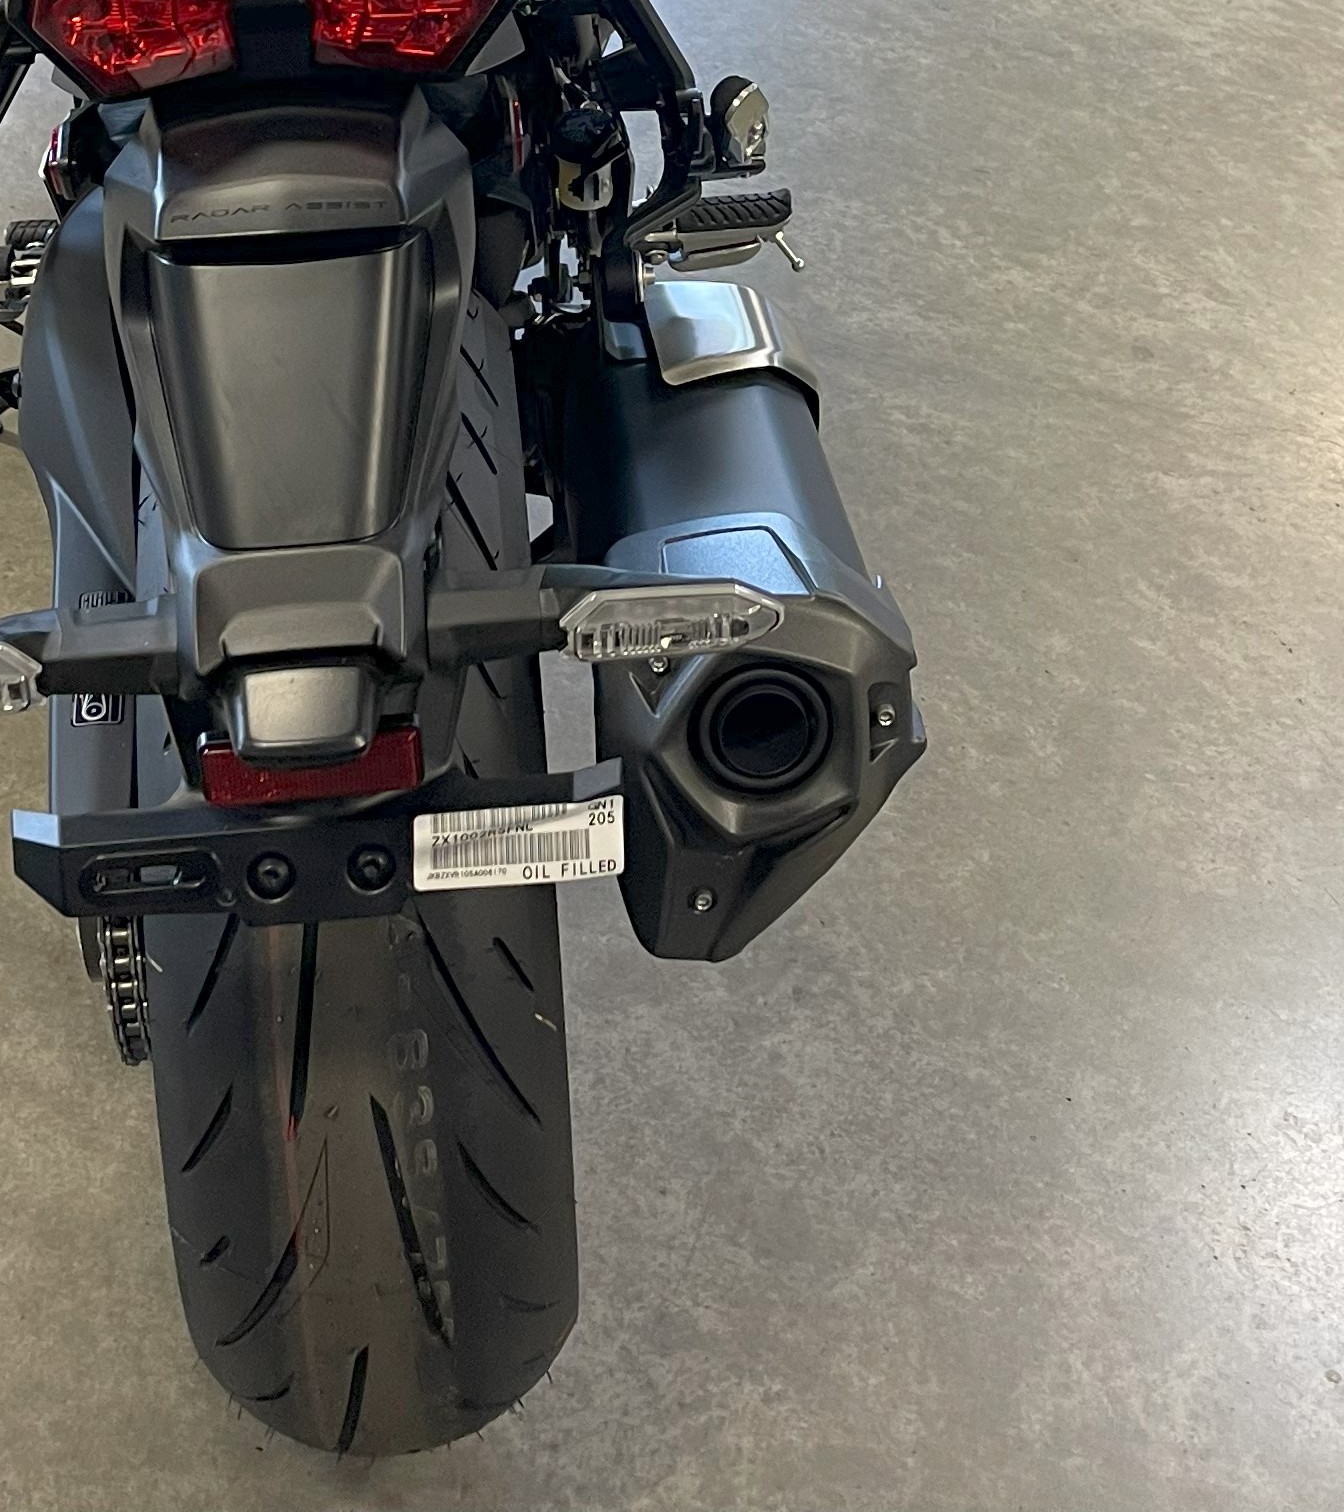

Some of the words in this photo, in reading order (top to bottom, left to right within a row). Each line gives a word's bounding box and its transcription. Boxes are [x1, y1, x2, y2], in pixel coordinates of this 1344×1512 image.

[170, 203, 271, 224] RADAR
[284, 200, 388, 211] ASSIST
[588, 810, 616, 826] 205
[522, 864, 551, 880] OIL
[560, 858, 617, 878] FILLED
